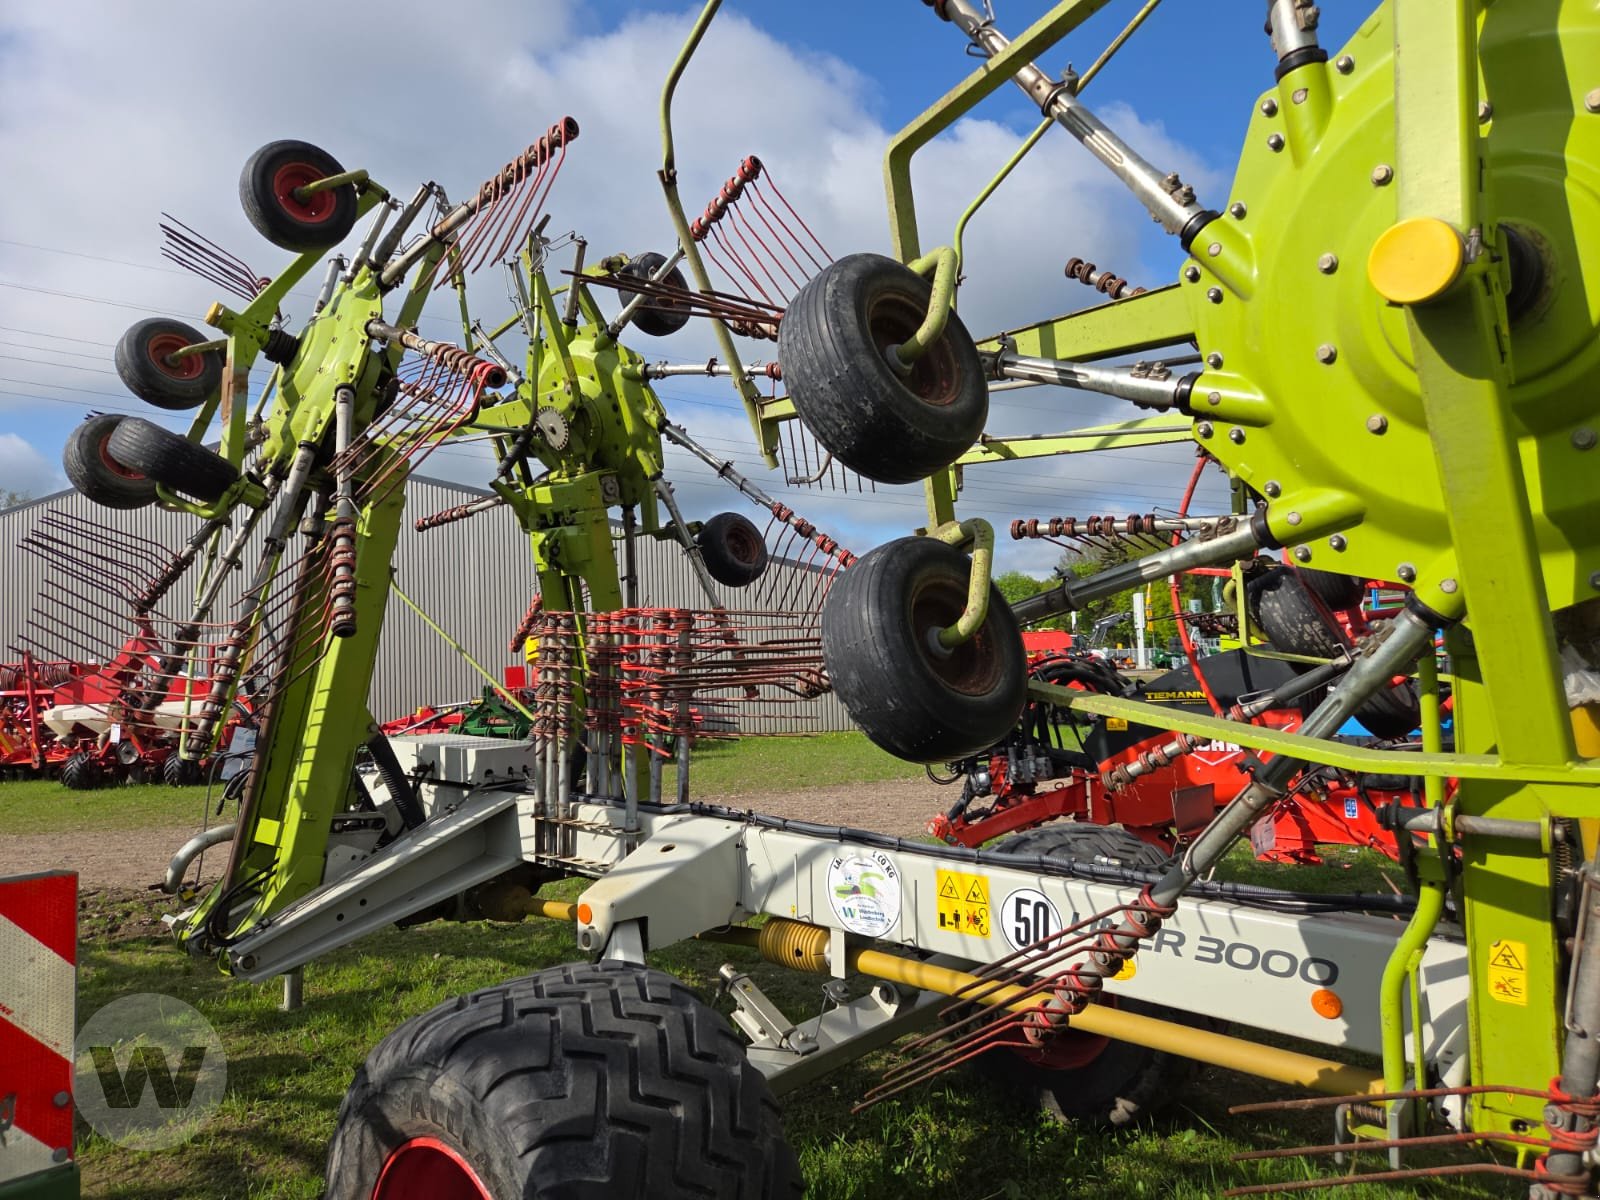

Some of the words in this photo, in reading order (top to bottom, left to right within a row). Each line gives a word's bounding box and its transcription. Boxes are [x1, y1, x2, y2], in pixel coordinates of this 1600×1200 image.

[1145, 691, 1208, 699] TIEMANN
[1015, 897, 1049, 951] 50
[1195, 935, 1339, 986] 3000
